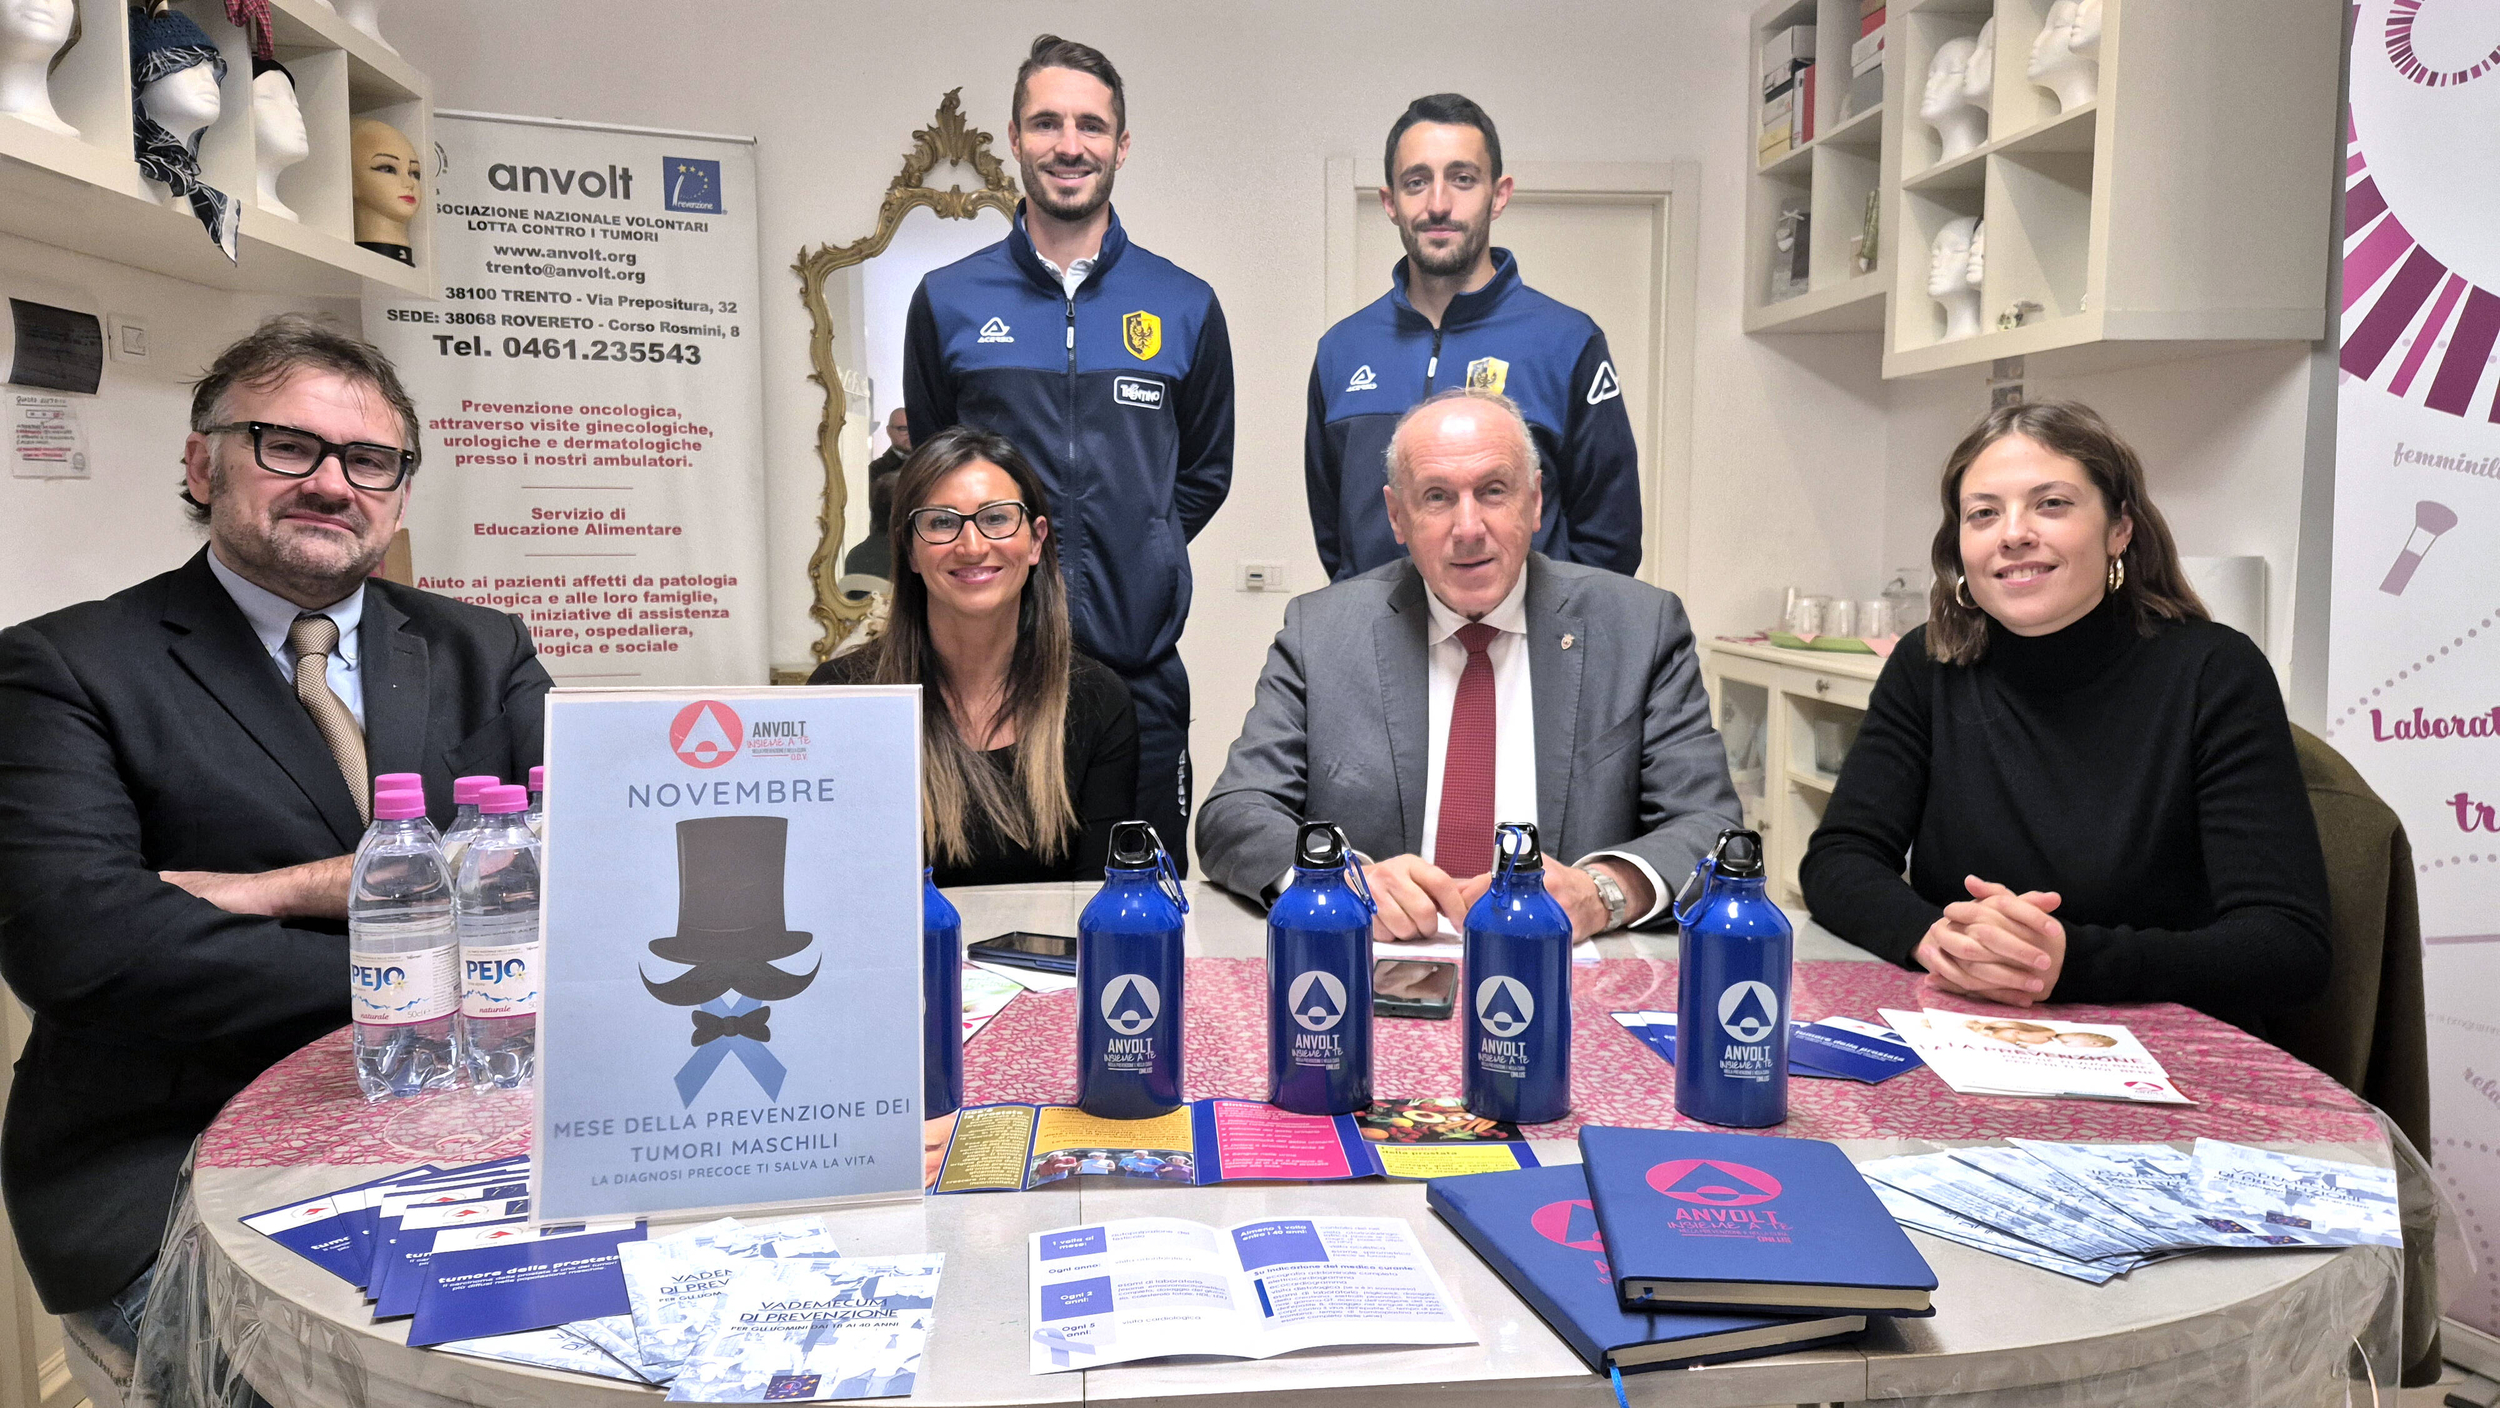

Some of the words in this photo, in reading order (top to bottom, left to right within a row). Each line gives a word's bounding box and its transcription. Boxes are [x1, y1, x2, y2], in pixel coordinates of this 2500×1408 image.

[487, 161, 633, 200] anvolt
[534, 209, 621, 226] NAZIONALE
[625, 215, 709, 232] VOLONTARI
[467, 220, 517, 233] LOTTA
[522, 223, 586, 238] CONTRO
[591, 227, 596, 238] I
[599, 228, 658, 242] TUMORI
[494, 244, 637, 265] www.anvolt.org
[486, 260, 646, 283] trento@anvolt.org
[445, 287, 497, 300] 38100
[501, 289, 572, 304] TRENTO
[586, 292, 613, 307] Via
[618, 295, 714, 314] Prepositura,
[718, 301, 738, 314] 32
[386, 308, 440, 324] SEDE:
[444, 311, 496, 326] 38068
[501, 314, 594, 330] ROVERETO
[608, 319, 656, 333] Corso
[660, 321, 726, 338] Rosmini,
[730, 325, 740, 338] 8
[432, 334, 492, 357] Tel.
[502, 336, 702, 365] 0461.235543
[461, 400, 574, 415] Prevenzione
[579, 403, 682, 419] oncologica,
[429, 417, 524, 432] attraverso
[530, 419, 580, 433] visite
[586, 420, 713, 438] ginecologiche,
[443, 435, 541, 450] urologiche
[547, 438, 558, 449] e
[563, 436, 702, 453] dermatologiche
[455, 453, 518, 468] presso
[523, 452, 529, 466] i
[534, 452, 588, 466] nostri
[593, 453, 693, 468] ambulatori.
[531, 508, 604, 521] Servizio
[609, 508, 626, 520] di
[473, 523, 580, 536] Educazione
[584, 523, 683, 536] Alimentare
[416, 576, 465, 589] Aiuto
[471, 576, 488, 589] ai
[494, 575, 566, 591] pazienti
[572, 574, 627, 588] affetti
[633, 575, 654, 588] da
[659, 573, 738, 589] patologia
[548, 594, 559, 604] e
[565, 591, 597, 604] alle
[603, 591, 638, 604] loro
[642, 590, 718, 606] famiglie,
[530, 608, 612, 621] iniziative
[617, 607, 633, 620] di
[638, 606, 730, 620] assistenza
[585, 624, 694, 639] ospedaliera,
[599, 644, 610, 654] e
[615, 640, 679, 653] sociale
[752, 721, 806, 738] ANVOLT
[746, 738, 784, 748] INSIEME
[788, 737, 795, 746] A
[797, 735, 811, 745] TE
[628, 778, 836, 808] NOVEMBRE
[351, 964, 405, 991] PEJO
[466, 958, 525, 984] PEJO
[479, 1005, 511, 1013] naturale
[1108, 1038, 1152, 1053] ANVOLT
[1296, 1034, 1339, 1049] ANVOLT
[1482, 1038, 1526, 1056] ANVOLT
[1137, 1053, 1143, 1061] A
[1324, 1049, 1330, 1057] A
[1509, 1056, 1515, 1064] A
[1725, 1045, 1770, 1061] ANVOLT
[1755, 1061, 1761, 1069] A
[553, 1118, 615, 1139] MESE
[624, 1114, 698, 1134] DELLA
[706, 1102, 866, 1128] PREVENZIONE
[876, 1098, 911, 1116] DEI
[631, 1141, 721, 1163] TUMORI
[731, 1132, 838, 1156] MASCHILI
[591, 1175, 609, 1187] LA
[614, 1170, 683, 1185] DIAGNOSI
[688, 1164, 752, 1179] PRECOCE
[757, 1163, 769, 1174] TI
[774, 1159, 818, 1173] SALVA
[823, 1157, 840, 1169] LA
[844, 1154, 875, 1168] VITA
[1676, 1208, 1779, 1224] ANVOLT
[1667, 1221, 1740, 1229] INSIEME
[1749, 1222, 1761, 1230] A
[1767, 1222, 1794, 1231] TE
[438, 1270, 502, 1284] tumore
[507, 1264, 548, 1275] della
[553, 1254, 621, 1271] prostata
[761, 1298, 888, 1310] VADEMECUM
[740, 1313, 759, 1322] DI
[766, 1309, 898, 1322] PREVENZIONE
